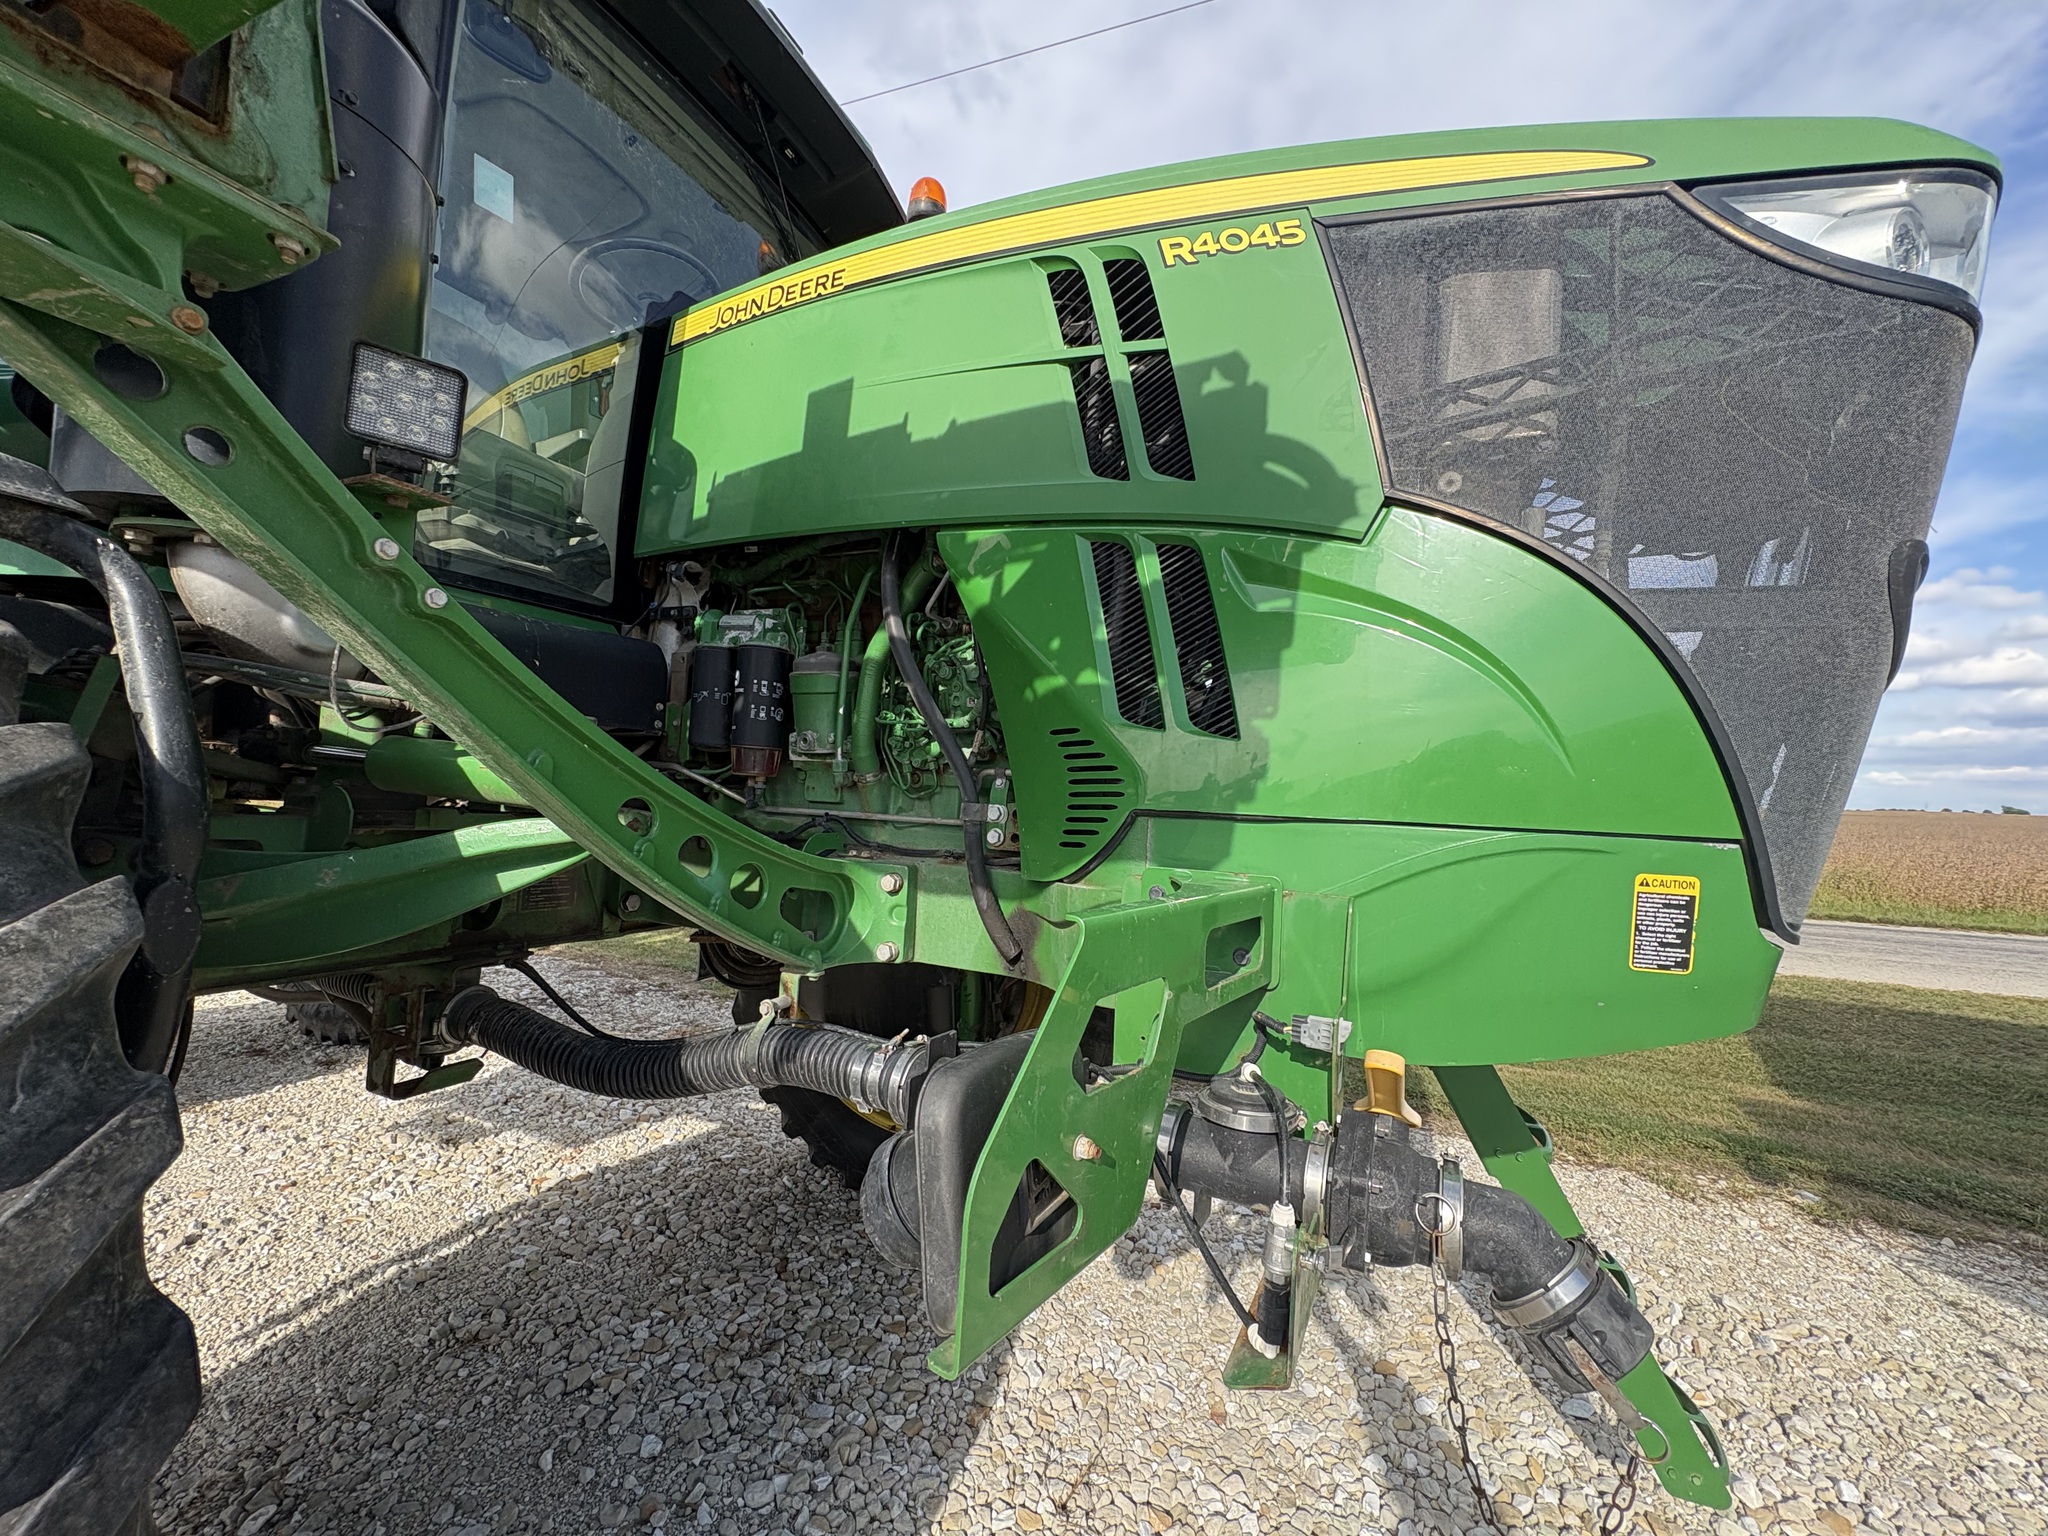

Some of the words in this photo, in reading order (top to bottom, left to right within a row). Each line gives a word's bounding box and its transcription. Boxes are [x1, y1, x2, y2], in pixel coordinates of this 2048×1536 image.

[1157, 218, 1307, 268] R4045
[709, 294, 764, 330] JOHN
[767, 268, 846, 309] DEERE
[1652, 878, 1696, 890] CAUTION
